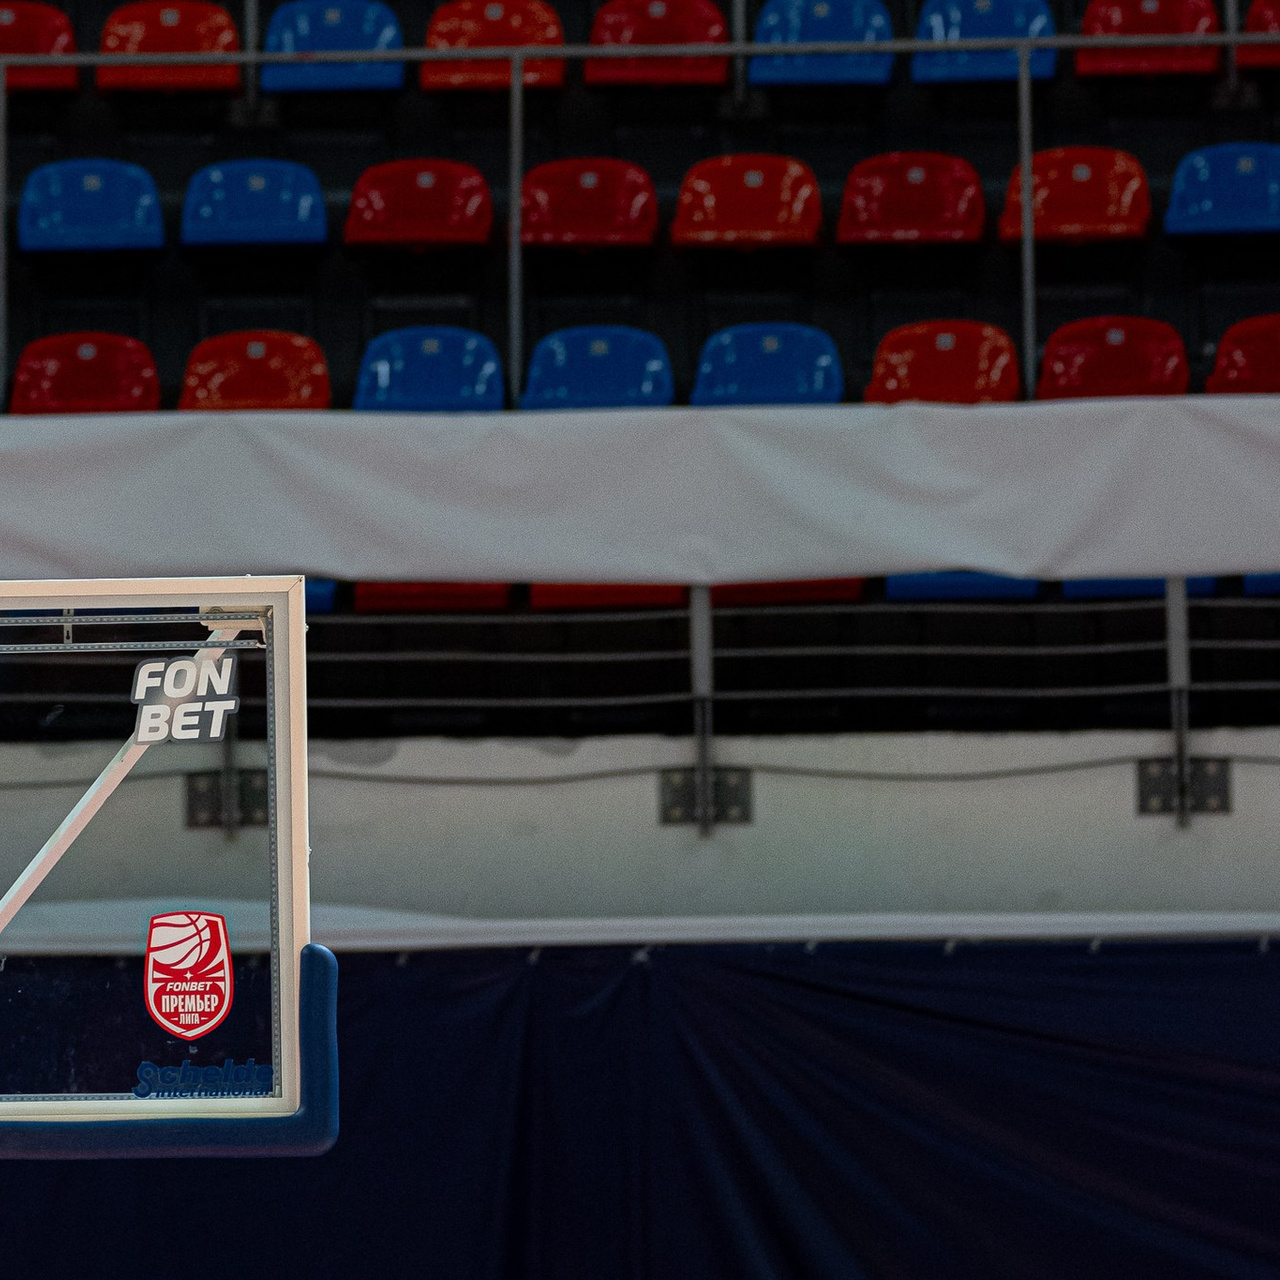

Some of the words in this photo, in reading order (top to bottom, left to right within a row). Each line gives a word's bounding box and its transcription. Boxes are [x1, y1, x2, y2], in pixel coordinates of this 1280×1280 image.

[134, 657, 233, 700] FON
[137, 700, 236, 742] BET
[166, 981, 213, 992] FONBET
[161, 994, 219, 1013] ПРЕМЬЕР
[179, 1013, 200, 1025] ЛИГА
